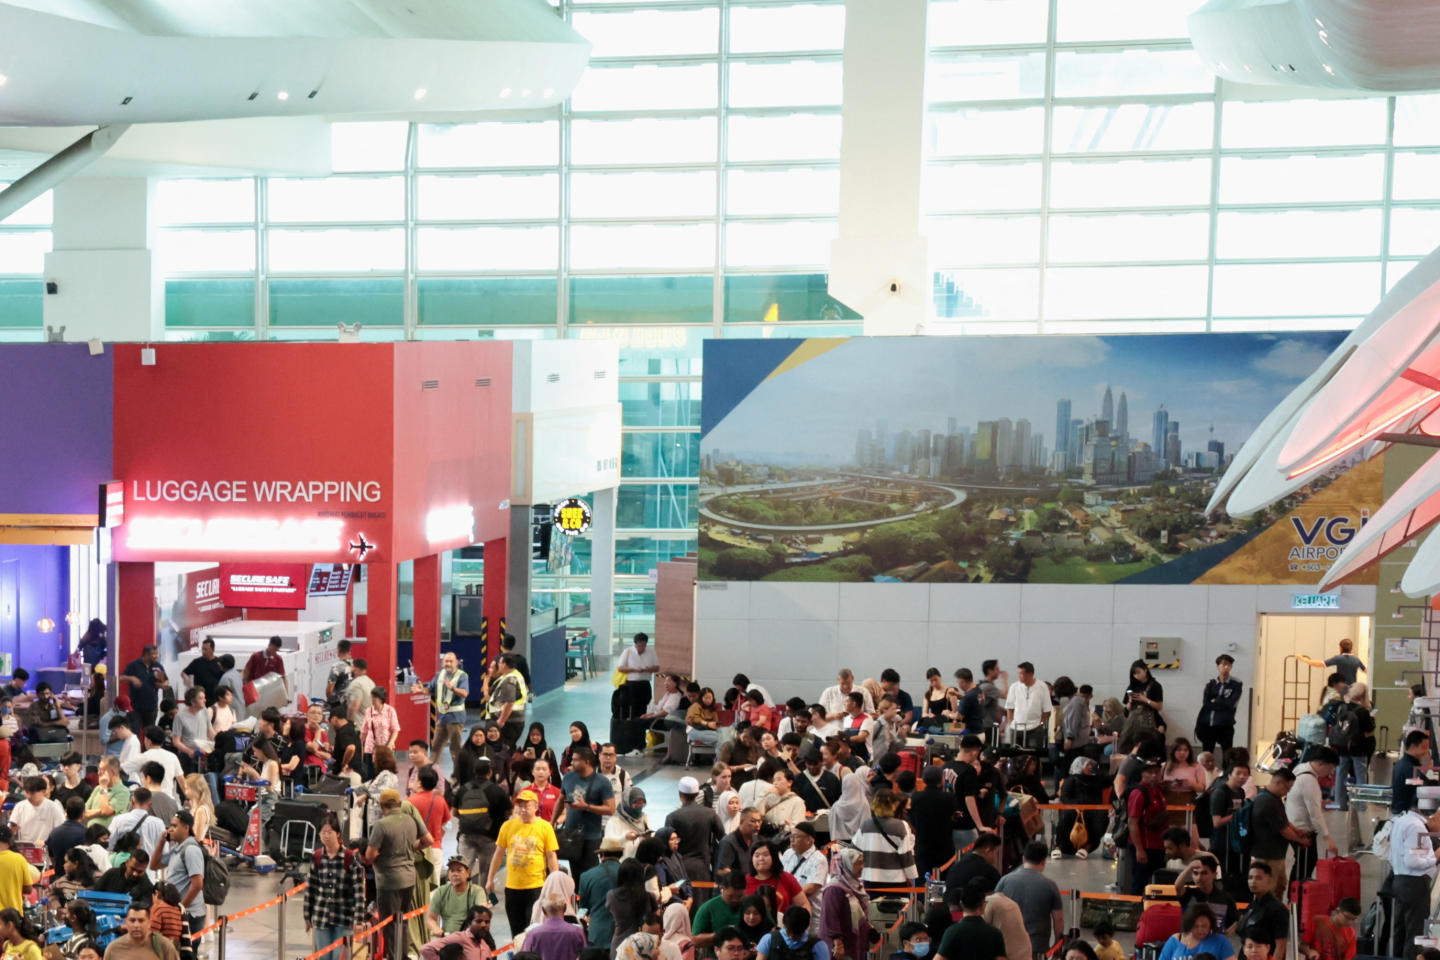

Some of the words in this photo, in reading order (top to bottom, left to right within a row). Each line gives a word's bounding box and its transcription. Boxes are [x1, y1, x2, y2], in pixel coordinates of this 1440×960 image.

[133, 480, 247, 502] LUGGAGE
[253, 480, 382, 502] WRAPPING
[230, 574, 265, 585] SECURE
[265, 576, 290, 586] SAFE
